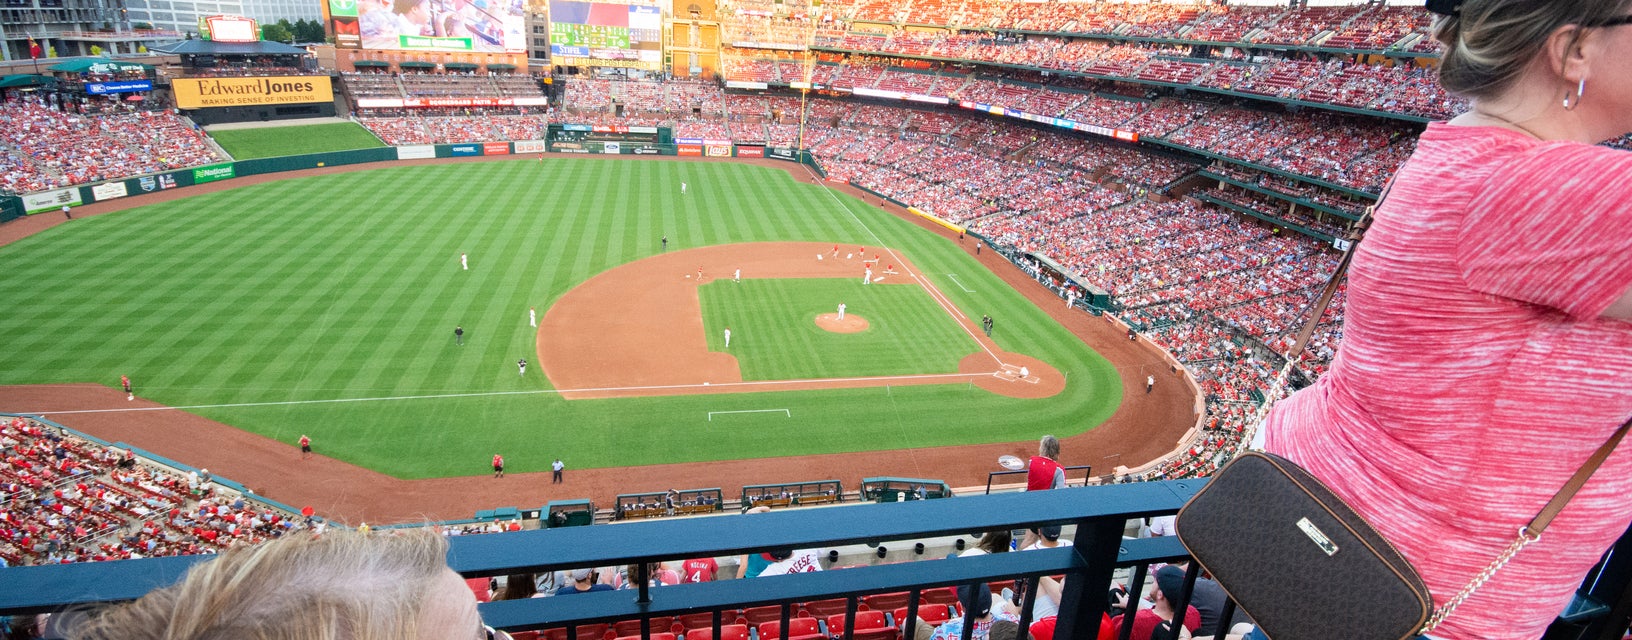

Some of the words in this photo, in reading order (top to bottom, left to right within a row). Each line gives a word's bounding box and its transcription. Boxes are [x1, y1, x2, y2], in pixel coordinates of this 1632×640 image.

[197, 79, 262, 96] Edward
[265, 78, 314, 95] Jones
[204, 166, 232, 176] National
[690, 562, 708, 570] MOLINA
[692, 570, 700, 582] 4
